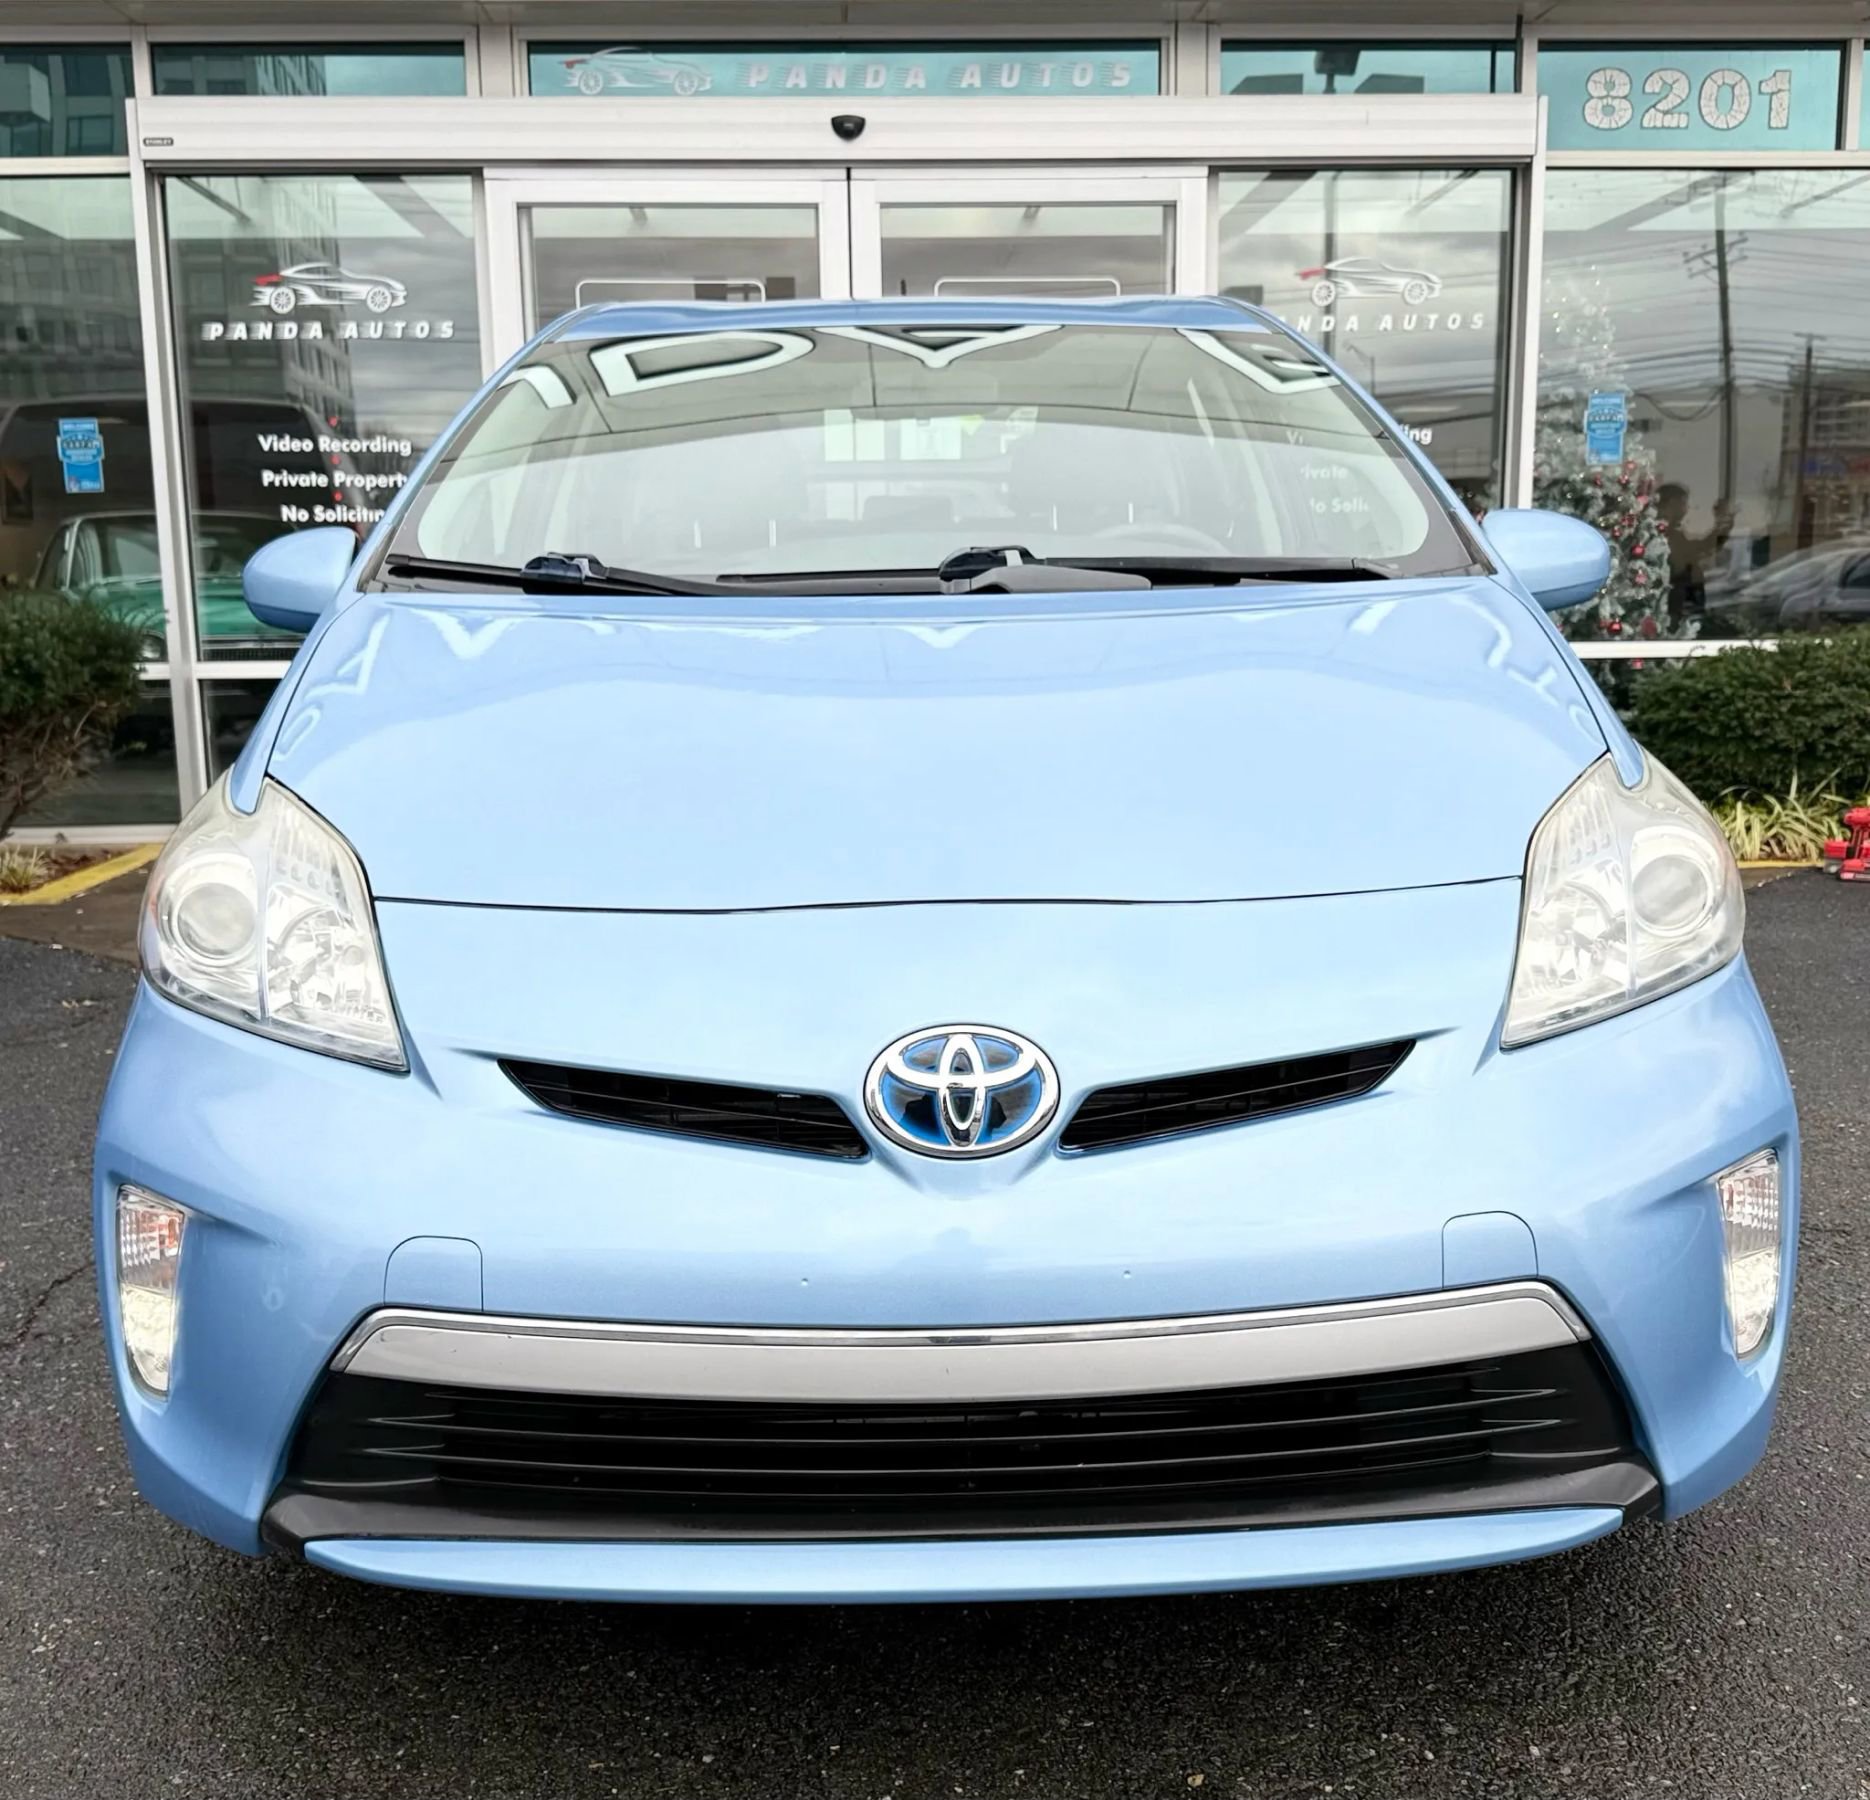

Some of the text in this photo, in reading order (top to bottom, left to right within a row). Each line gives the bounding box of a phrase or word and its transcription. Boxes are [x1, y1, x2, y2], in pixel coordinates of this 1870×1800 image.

[743, 63, 1131, 89] PANDA AUTOS
[1582, 67, 1793, 131] 8201
[204, 320, 455, 341] PANDA AUTOS
[1280, 313, 1485, 332] NDA AUTOS
[257, 433, 412, 457] Video Recording
[261, 469, 329, 488] Private
[280, 504, 385, 523] No Solicitin
